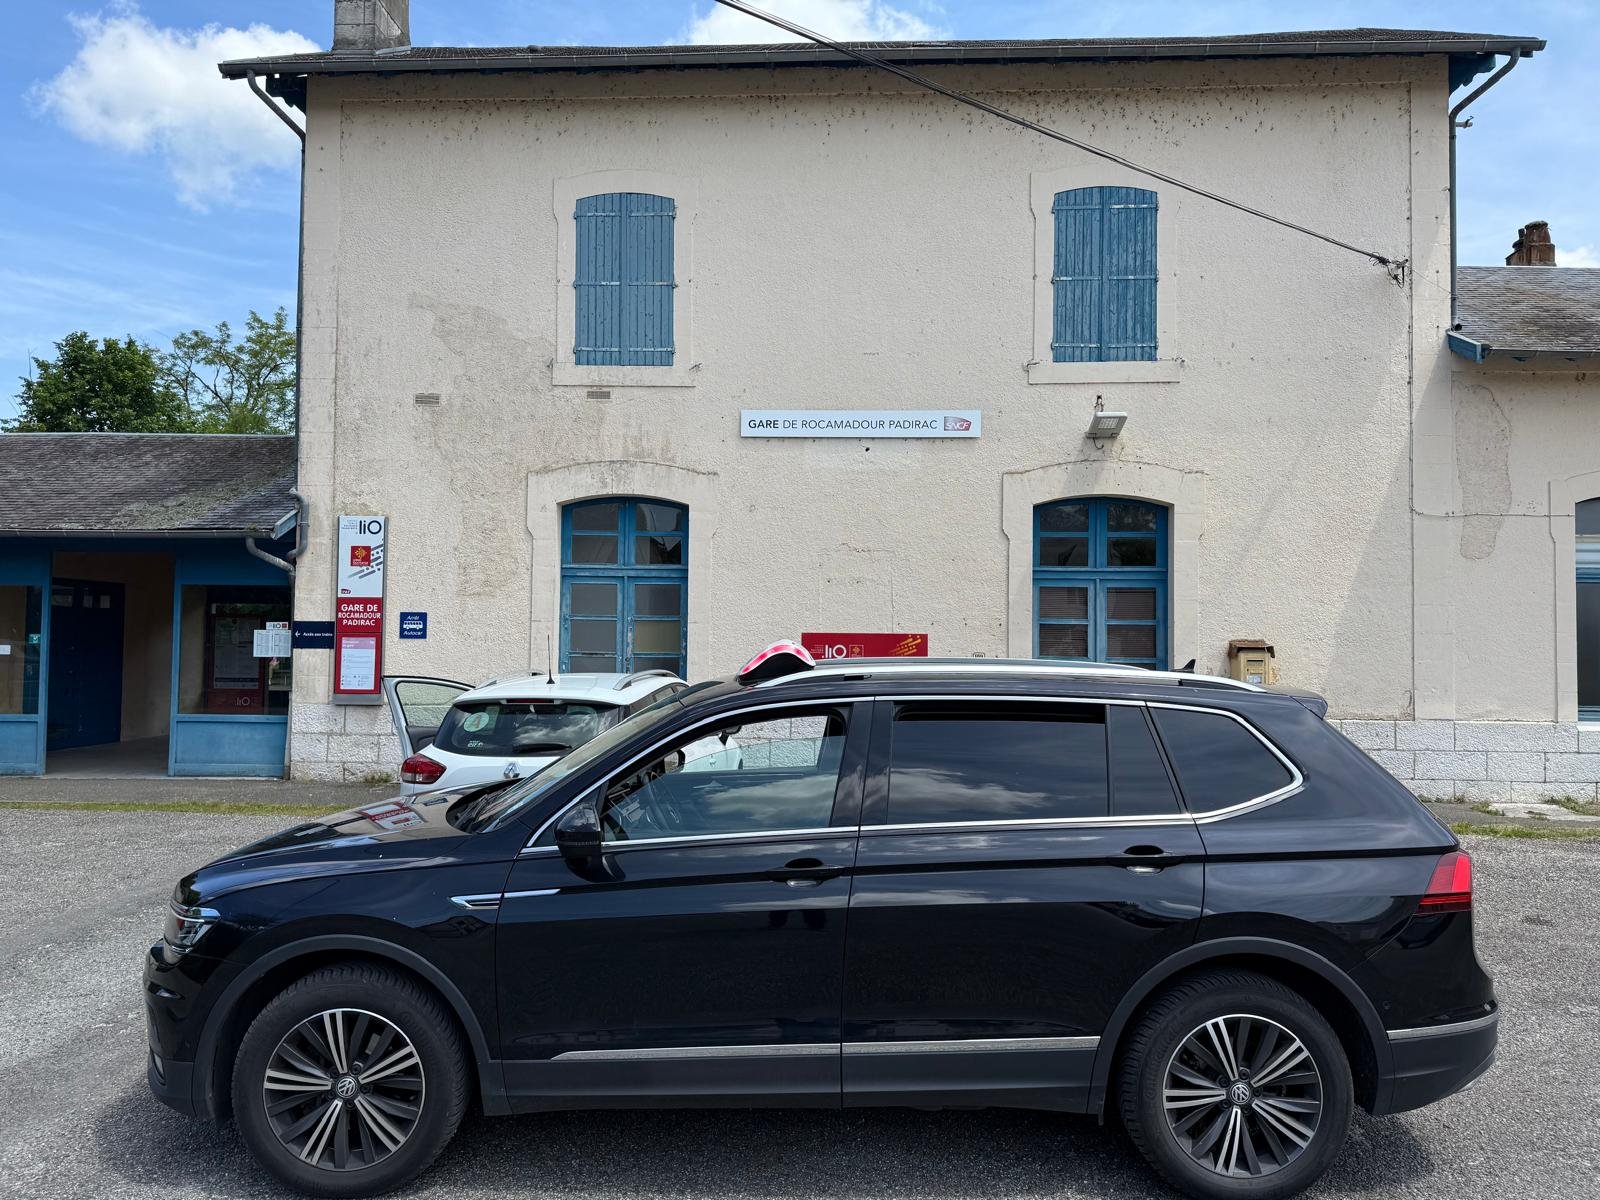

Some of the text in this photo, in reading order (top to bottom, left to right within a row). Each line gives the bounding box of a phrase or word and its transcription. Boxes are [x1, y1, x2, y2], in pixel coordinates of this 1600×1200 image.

[748, 419, 970, 430] GARE DE ROCAMADOUR PADIRAC SNCF
[341, 604, 378, 612] GARE DE
